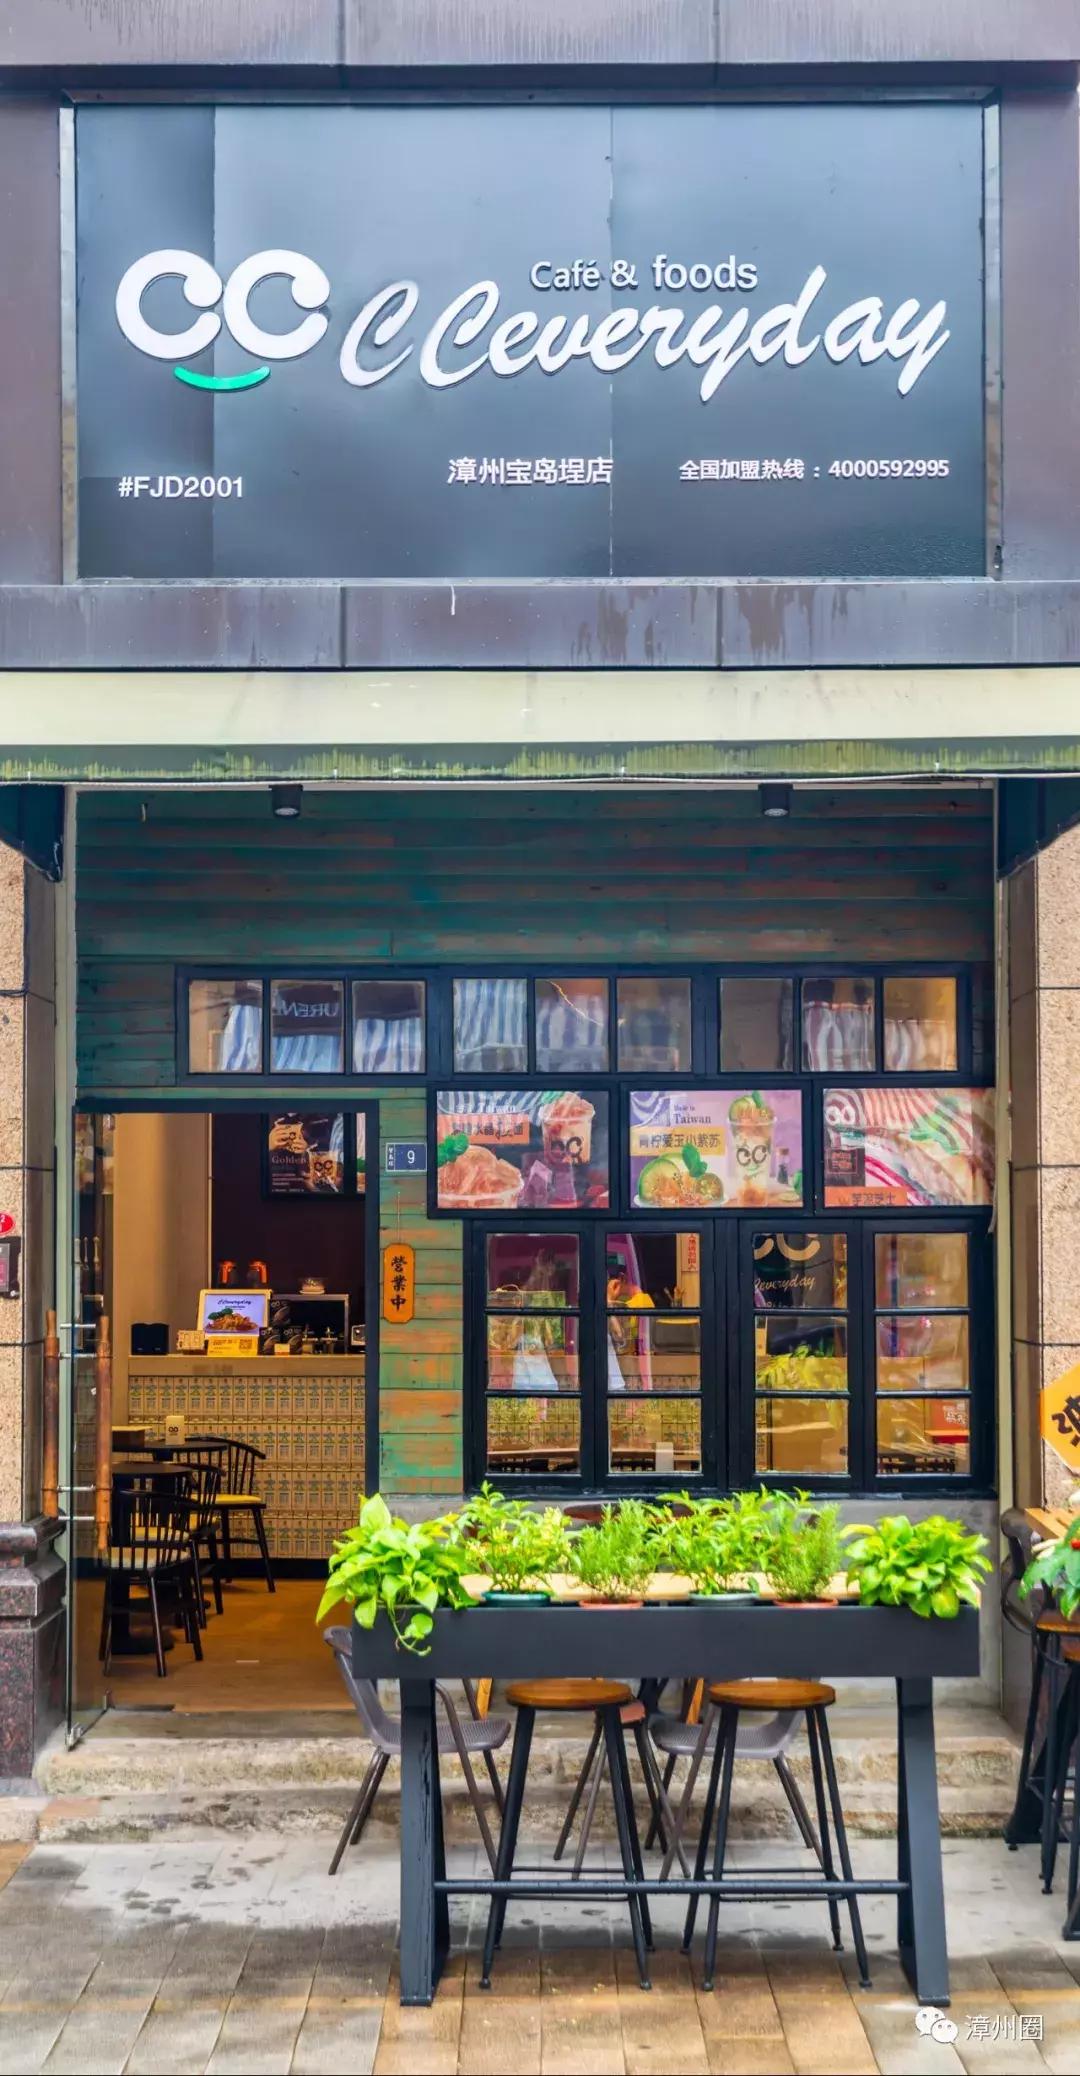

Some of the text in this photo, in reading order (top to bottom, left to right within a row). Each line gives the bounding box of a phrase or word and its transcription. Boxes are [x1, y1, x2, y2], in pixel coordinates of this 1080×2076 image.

[530, 254, 758, 290] Café & foods
[447, 457, 613, 486] 漳州宝岛埕店
[118, 475, 244, 499] #FJD2001
[674, 1113, 712, 1124] Taiwan
[407, 1150, 416, 1164] 9
[390, 1256, 408, 1312] 營業中
